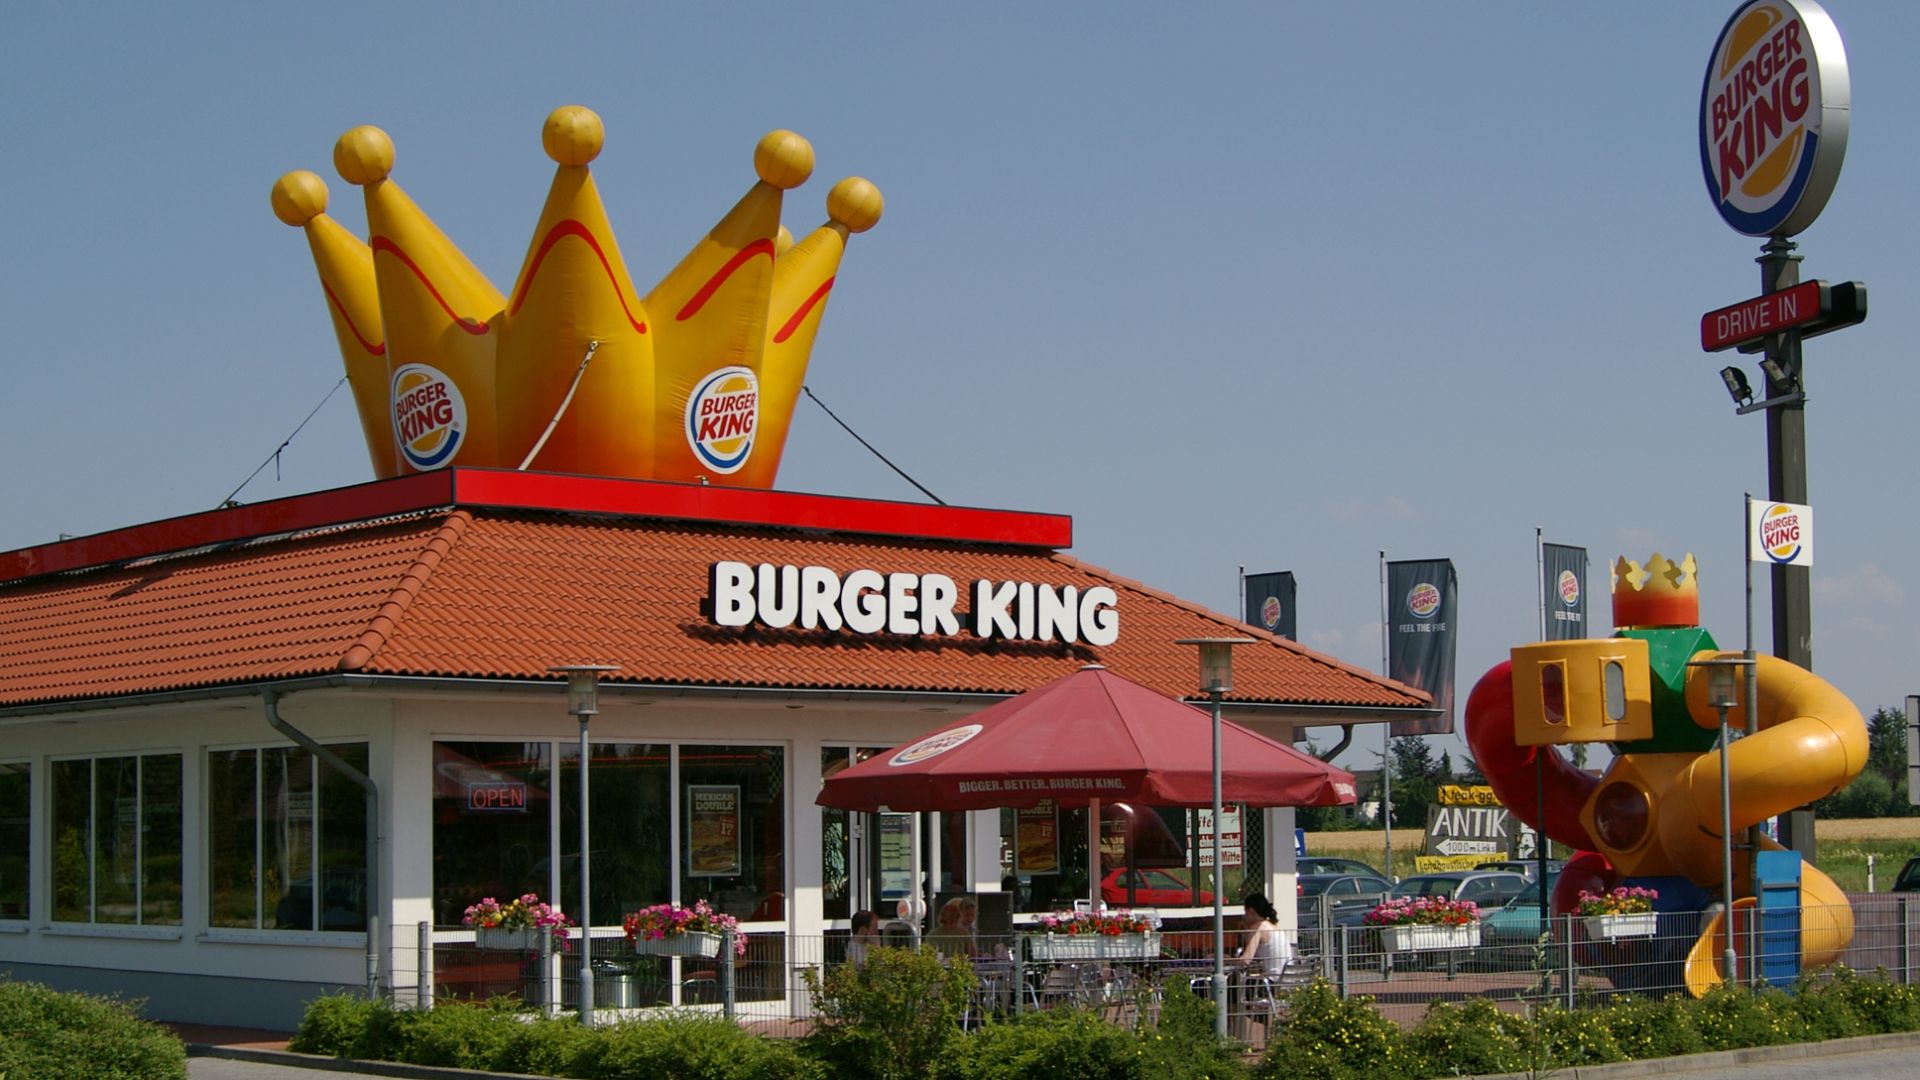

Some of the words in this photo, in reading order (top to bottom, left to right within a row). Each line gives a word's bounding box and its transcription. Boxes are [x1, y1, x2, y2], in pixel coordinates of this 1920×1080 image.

[1711, 18, 1803, 144] BURGER
[1717, 57, 1810, 201] KING
[1717, 301, 1770, 340] DRIVE
[1777, 294, 1798, 323] IN
[396, 382, 447, 421] BURGER
[701, 393, 756, 416] BURGER
[400, 399, 453, 446] KING
[698, 410, 754, 441] KING
[1764, 515, 1799, 534] BURGER
[1765, 526, 1800, 550] KING
[714, 560, 960, 637] BURGER
[976, 578, 1120, 646] KING
[1411, 595, 1438, 609] KING
[1416, 623, 1431, 633] THE
[473, 788, 523, 809] OPEN
[959, 780, 1003, 793] BIGGER.
[1004, 778, 1049, 790] BETTER.
[1050, 778, 1094, 789] BURGER
[1095, 777, 1126, 789] KING.
[695, 801, 735, 811] DOUBLE
[1431, 807, 1509, 838] ANTIK
